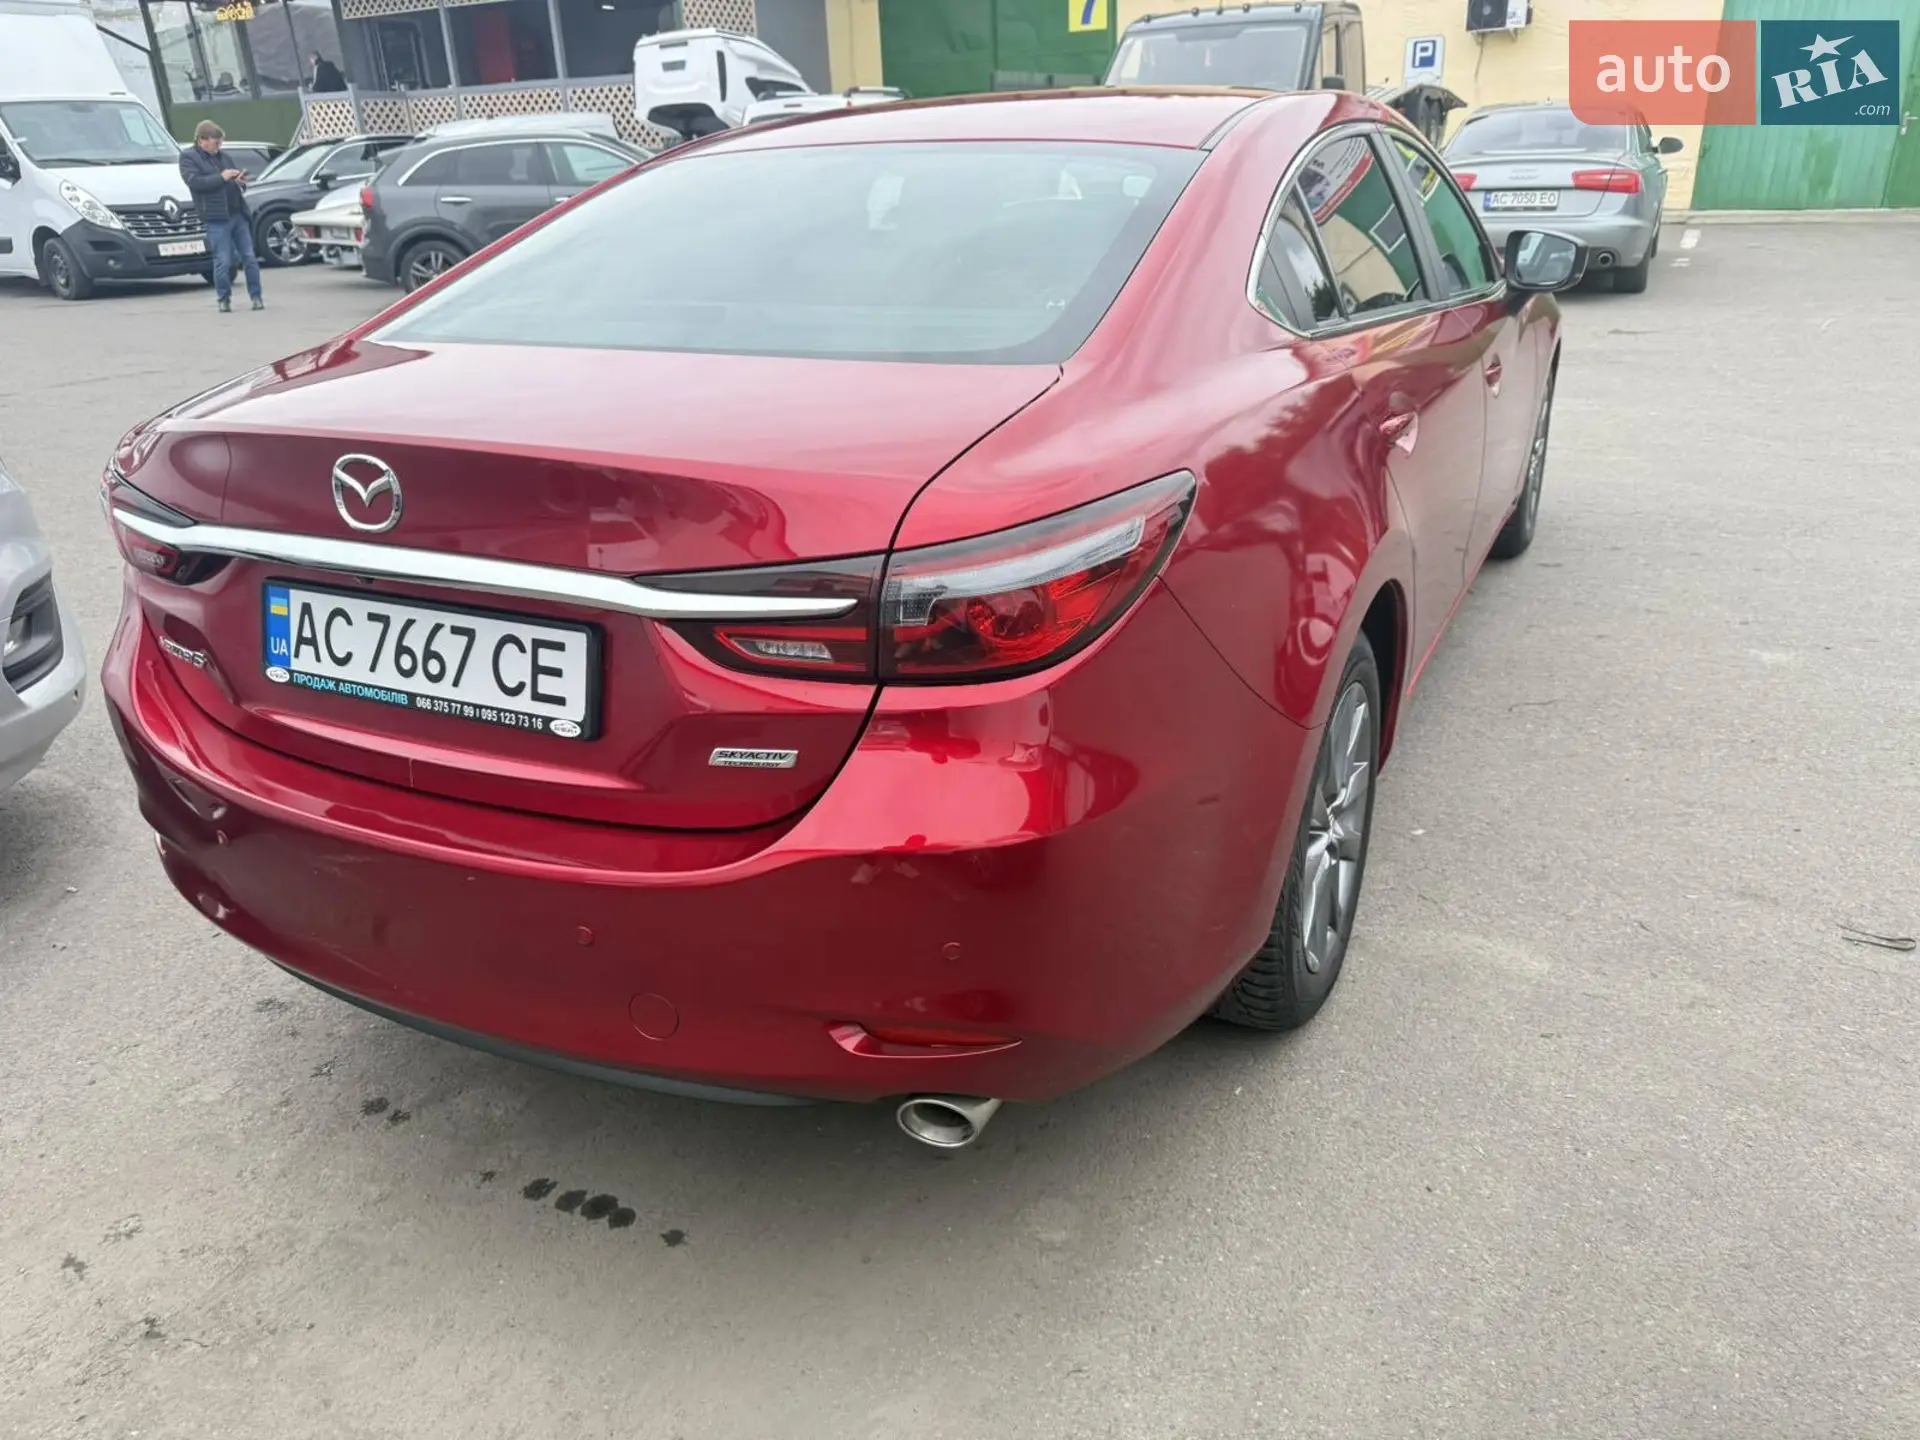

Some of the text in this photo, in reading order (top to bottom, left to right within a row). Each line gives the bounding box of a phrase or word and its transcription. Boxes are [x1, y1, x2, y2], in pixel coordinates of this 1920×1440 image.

[1415, 43, 1433, 67] P
[1492, 192, 1556, 204] AC 7050 EO
[271, 636, 288, 657] UA
[293, 602, 353, 667] AC
[367, 611, 476, 688] 7667
[492, 633, 567, 707] CE
[293, 672, 336, 691] ПРОДАЖ
[338, 683, 409, 705] АВТОМОБІЛІВ
[416, 696, 432, 710] 066
[434, 699, 449, 713] 375
[451, 703, 461, 715] 77
[463, 705, 474, 718] 99
[481, 709, 498, 722] 095
[499, 711, 516, 725] 123
[518, 715, 529, 728] 73
[532, 717, 543, 730] 16
[718, 750, 790, 760] SKYACTIV
